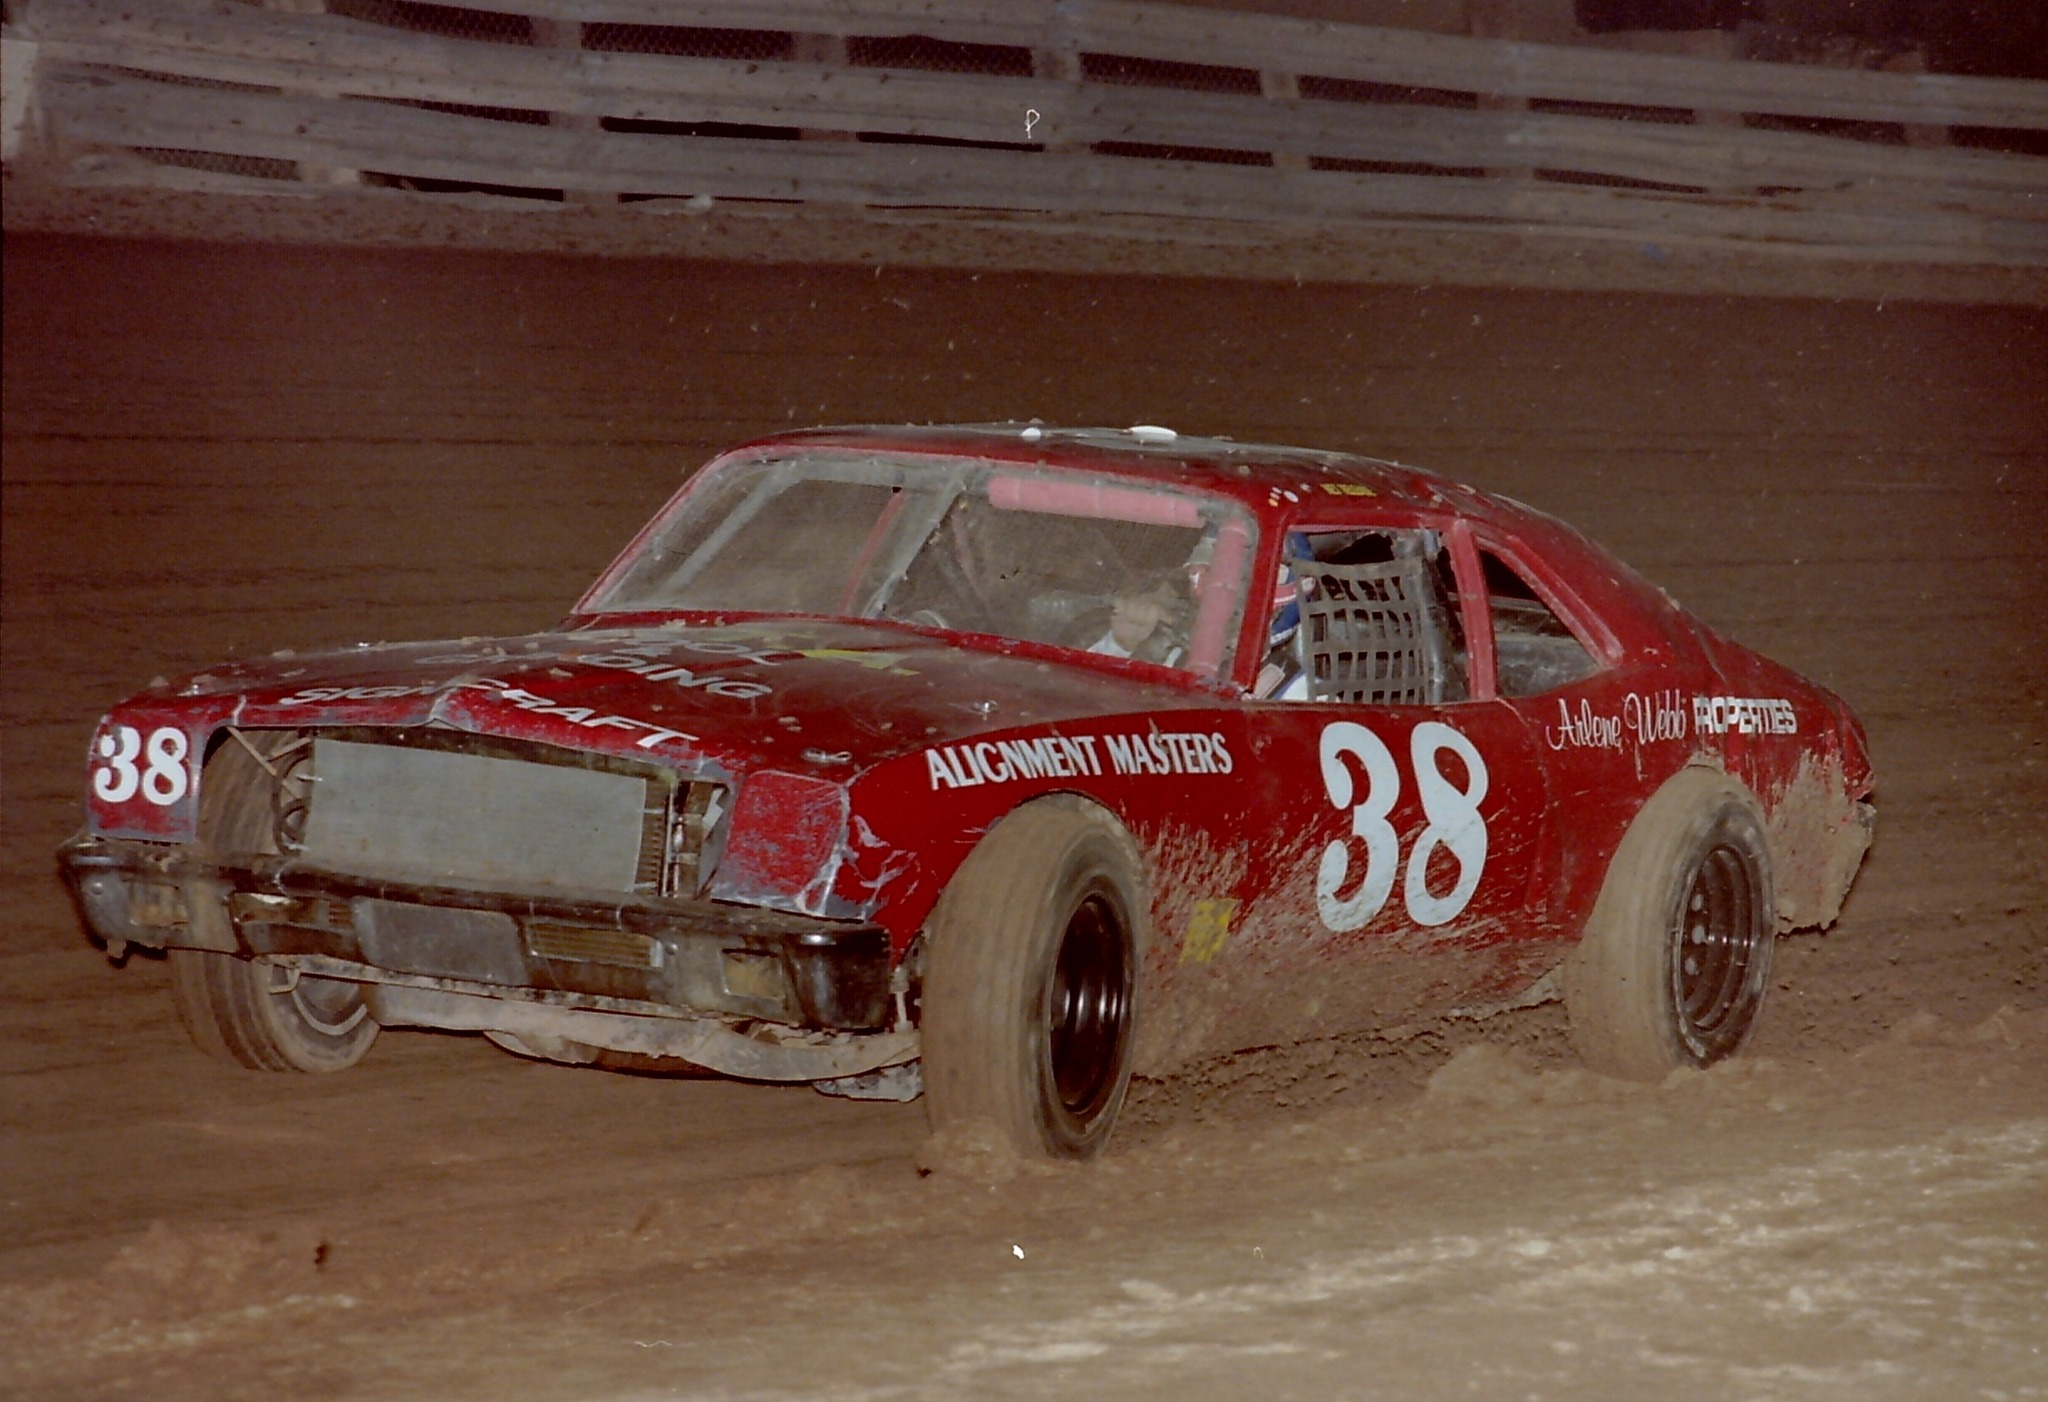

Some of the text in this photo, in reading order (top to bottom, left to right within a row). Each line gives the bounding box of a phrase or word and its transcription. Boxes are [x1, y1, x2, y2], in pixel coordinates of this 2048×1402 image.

[1623, 688, 1686, 745] Webb
[95, 726, 188, 806] 38
[925, 732, 1233, 790] ALIGNMENT MASTERS
[1317, 721, 1489, 933] 38
